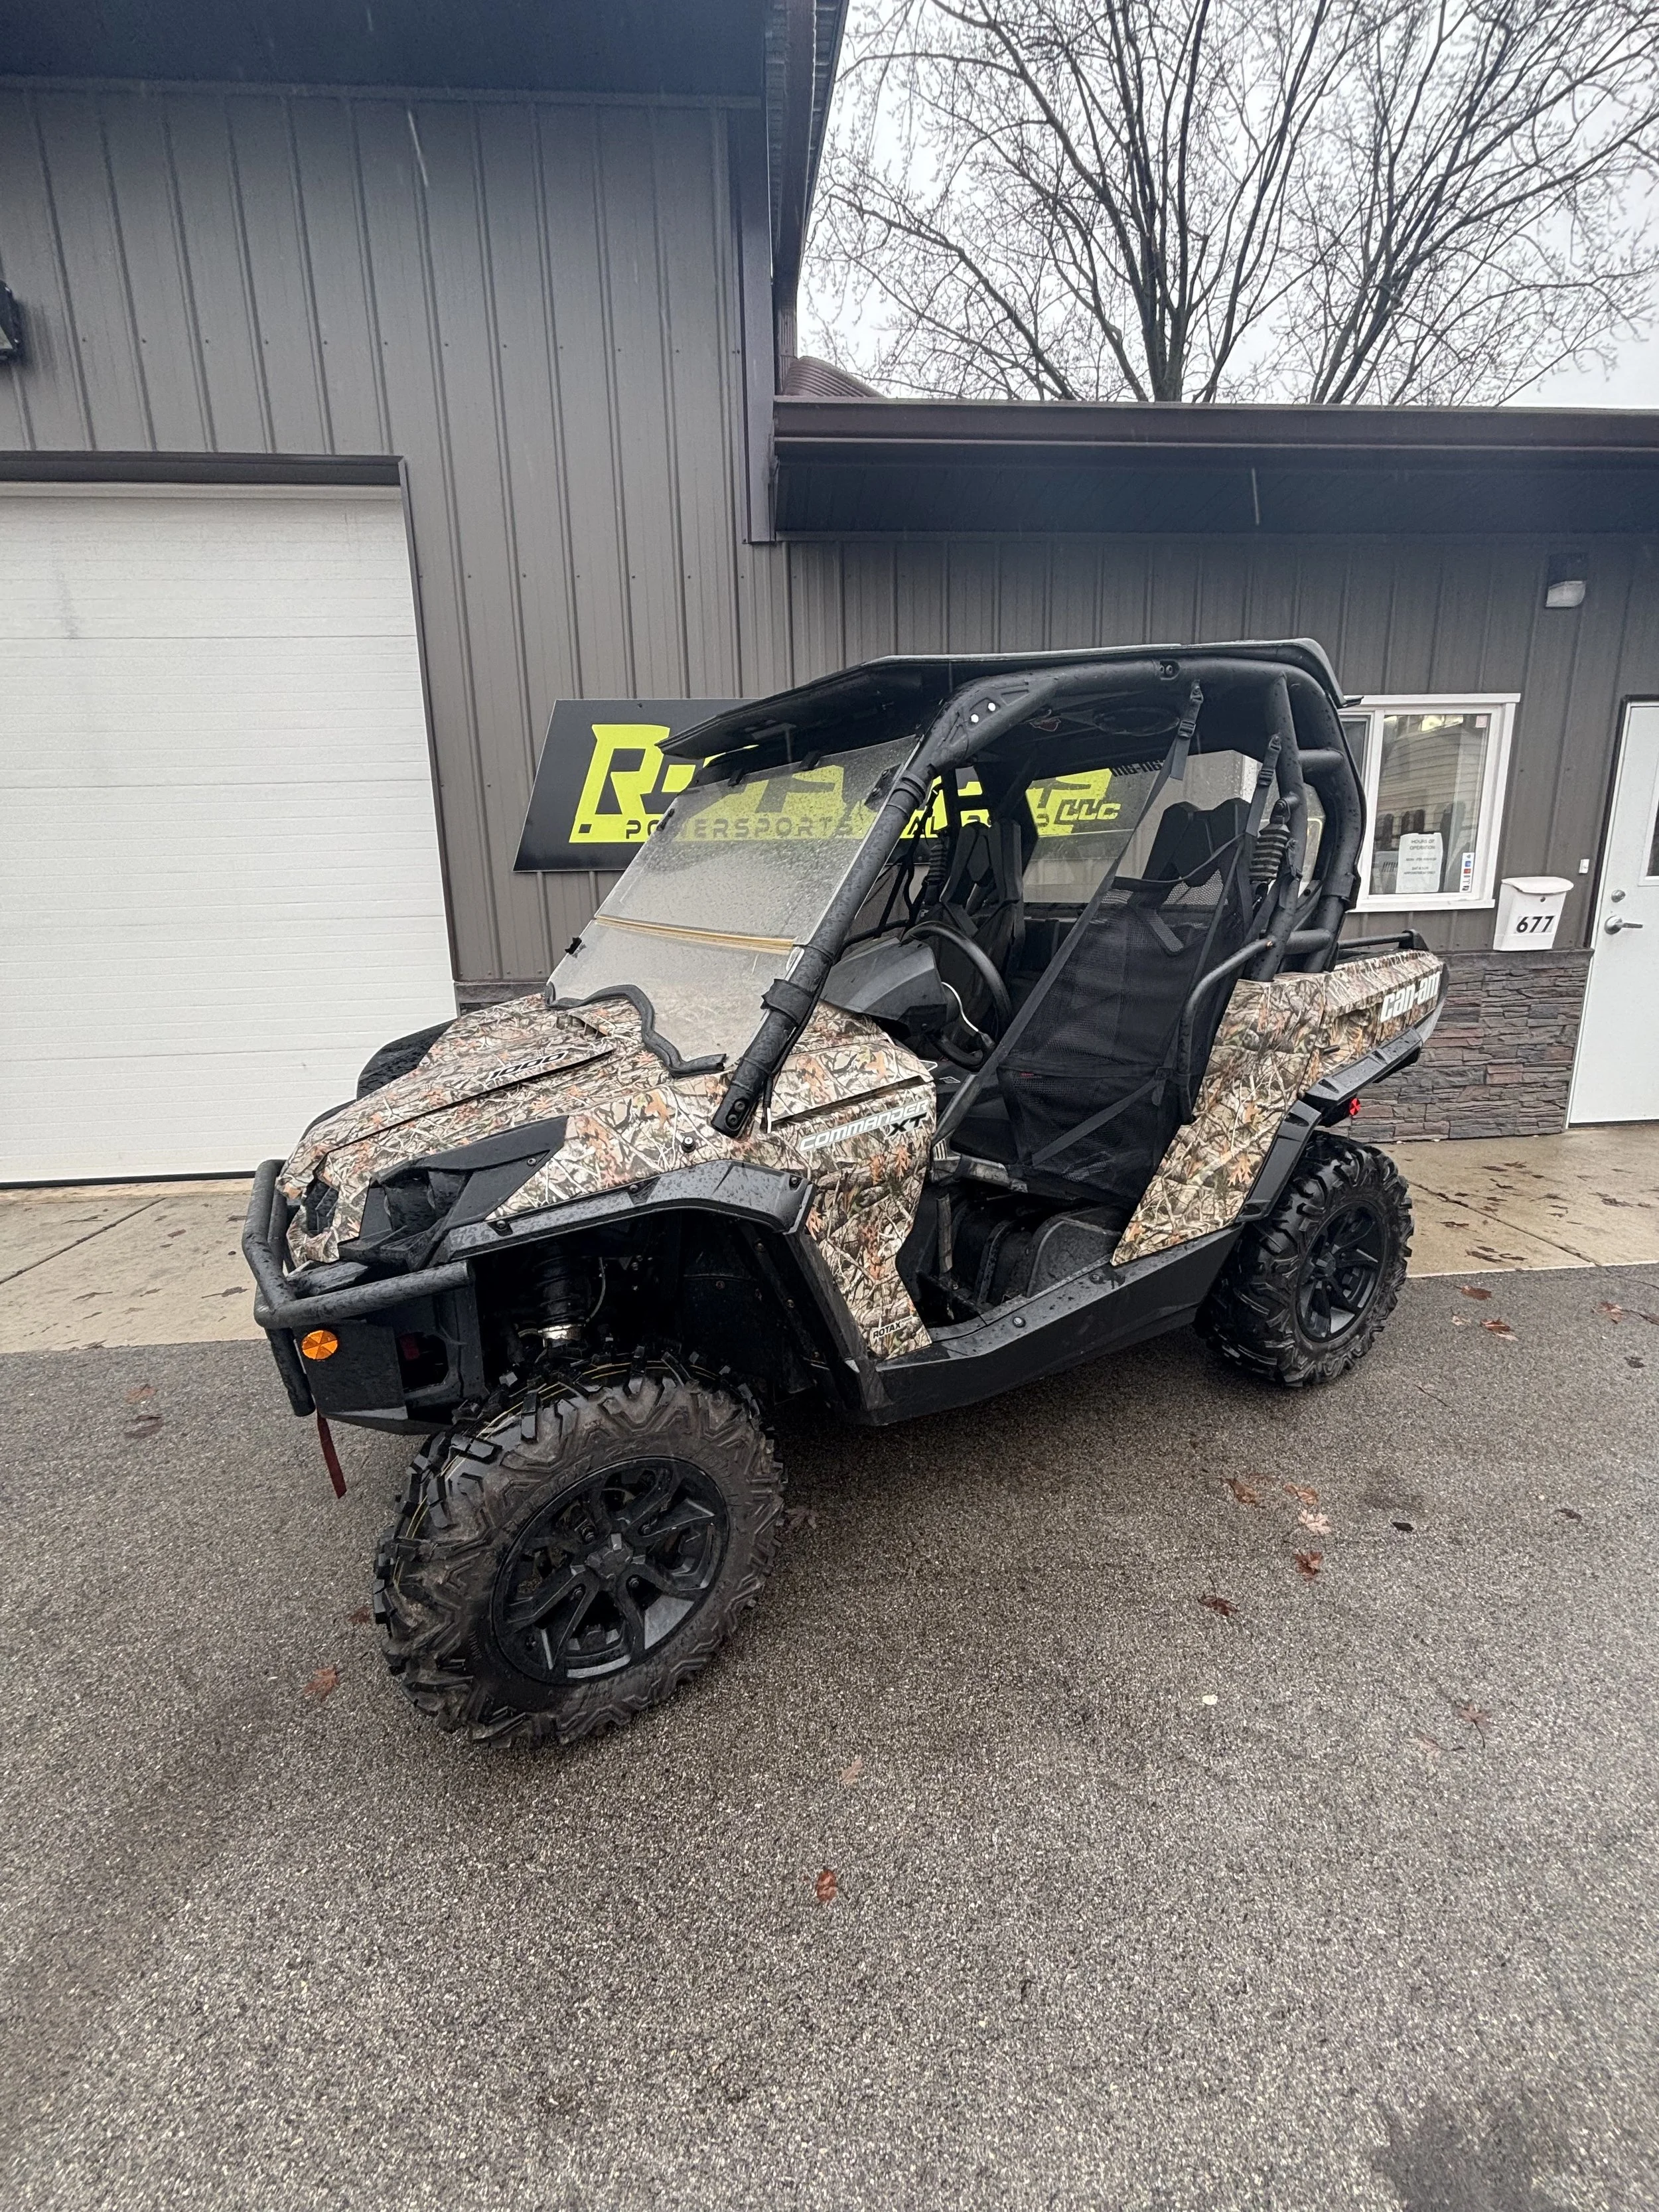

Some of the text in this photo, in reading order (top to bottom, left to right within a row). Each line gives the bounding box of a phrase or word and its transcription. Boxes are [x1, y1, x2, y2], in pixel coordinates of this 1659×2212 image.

[1060, 802, 1121, 821] LLC
[1516, 916, 1555, 933] 677
[490, 1053, 565, 1080] 1000
[799, 1098, 929, 1152] COMMANDER
[888, 1112, 928, 1136] XT
[873, 1321, 901, 1339] ROTAX
